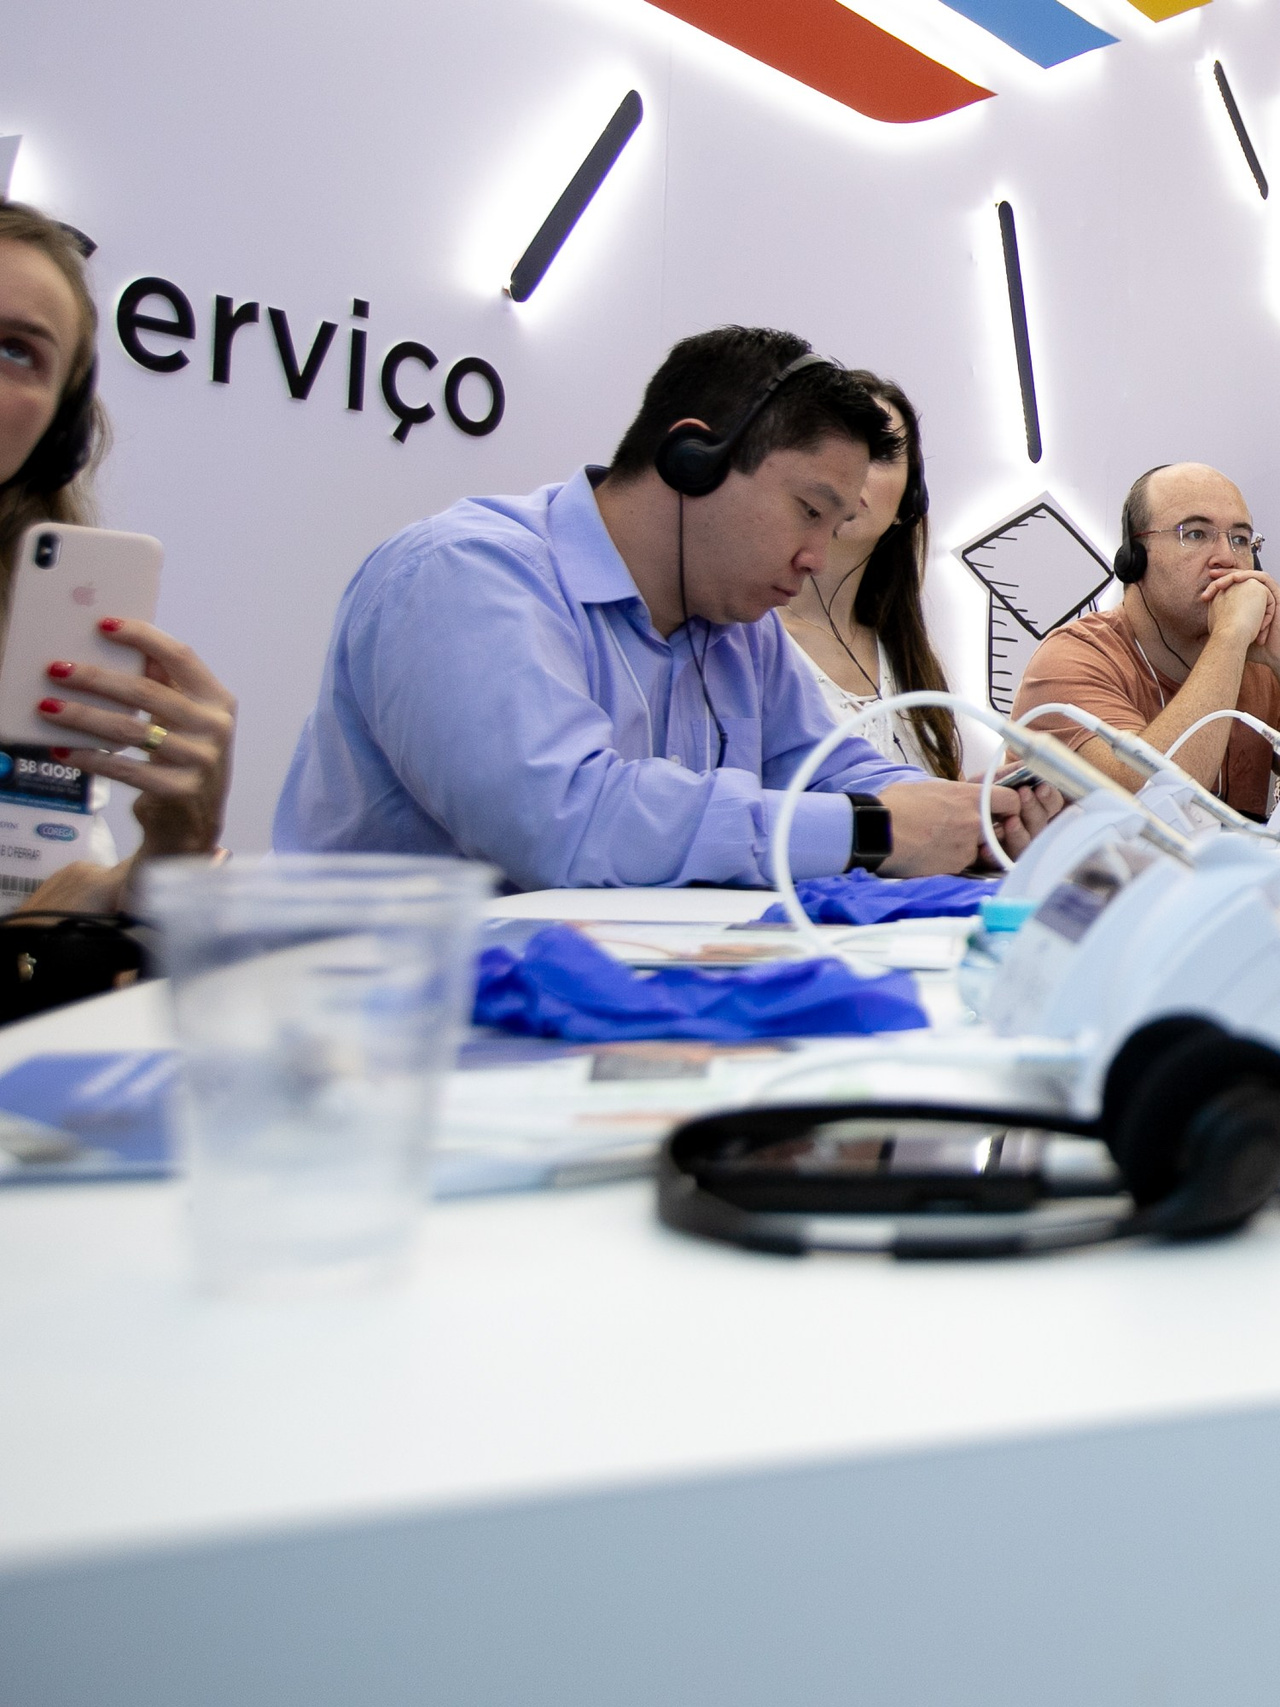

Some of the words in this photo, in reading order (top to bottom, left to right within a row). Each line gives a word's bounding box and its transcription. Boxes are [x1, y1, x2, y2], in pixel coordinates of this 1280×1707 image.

[58, 221, 506, 443] erviço
[18, 758, 37, 773] 38
[40, 762, 82, 780] CIOSP
